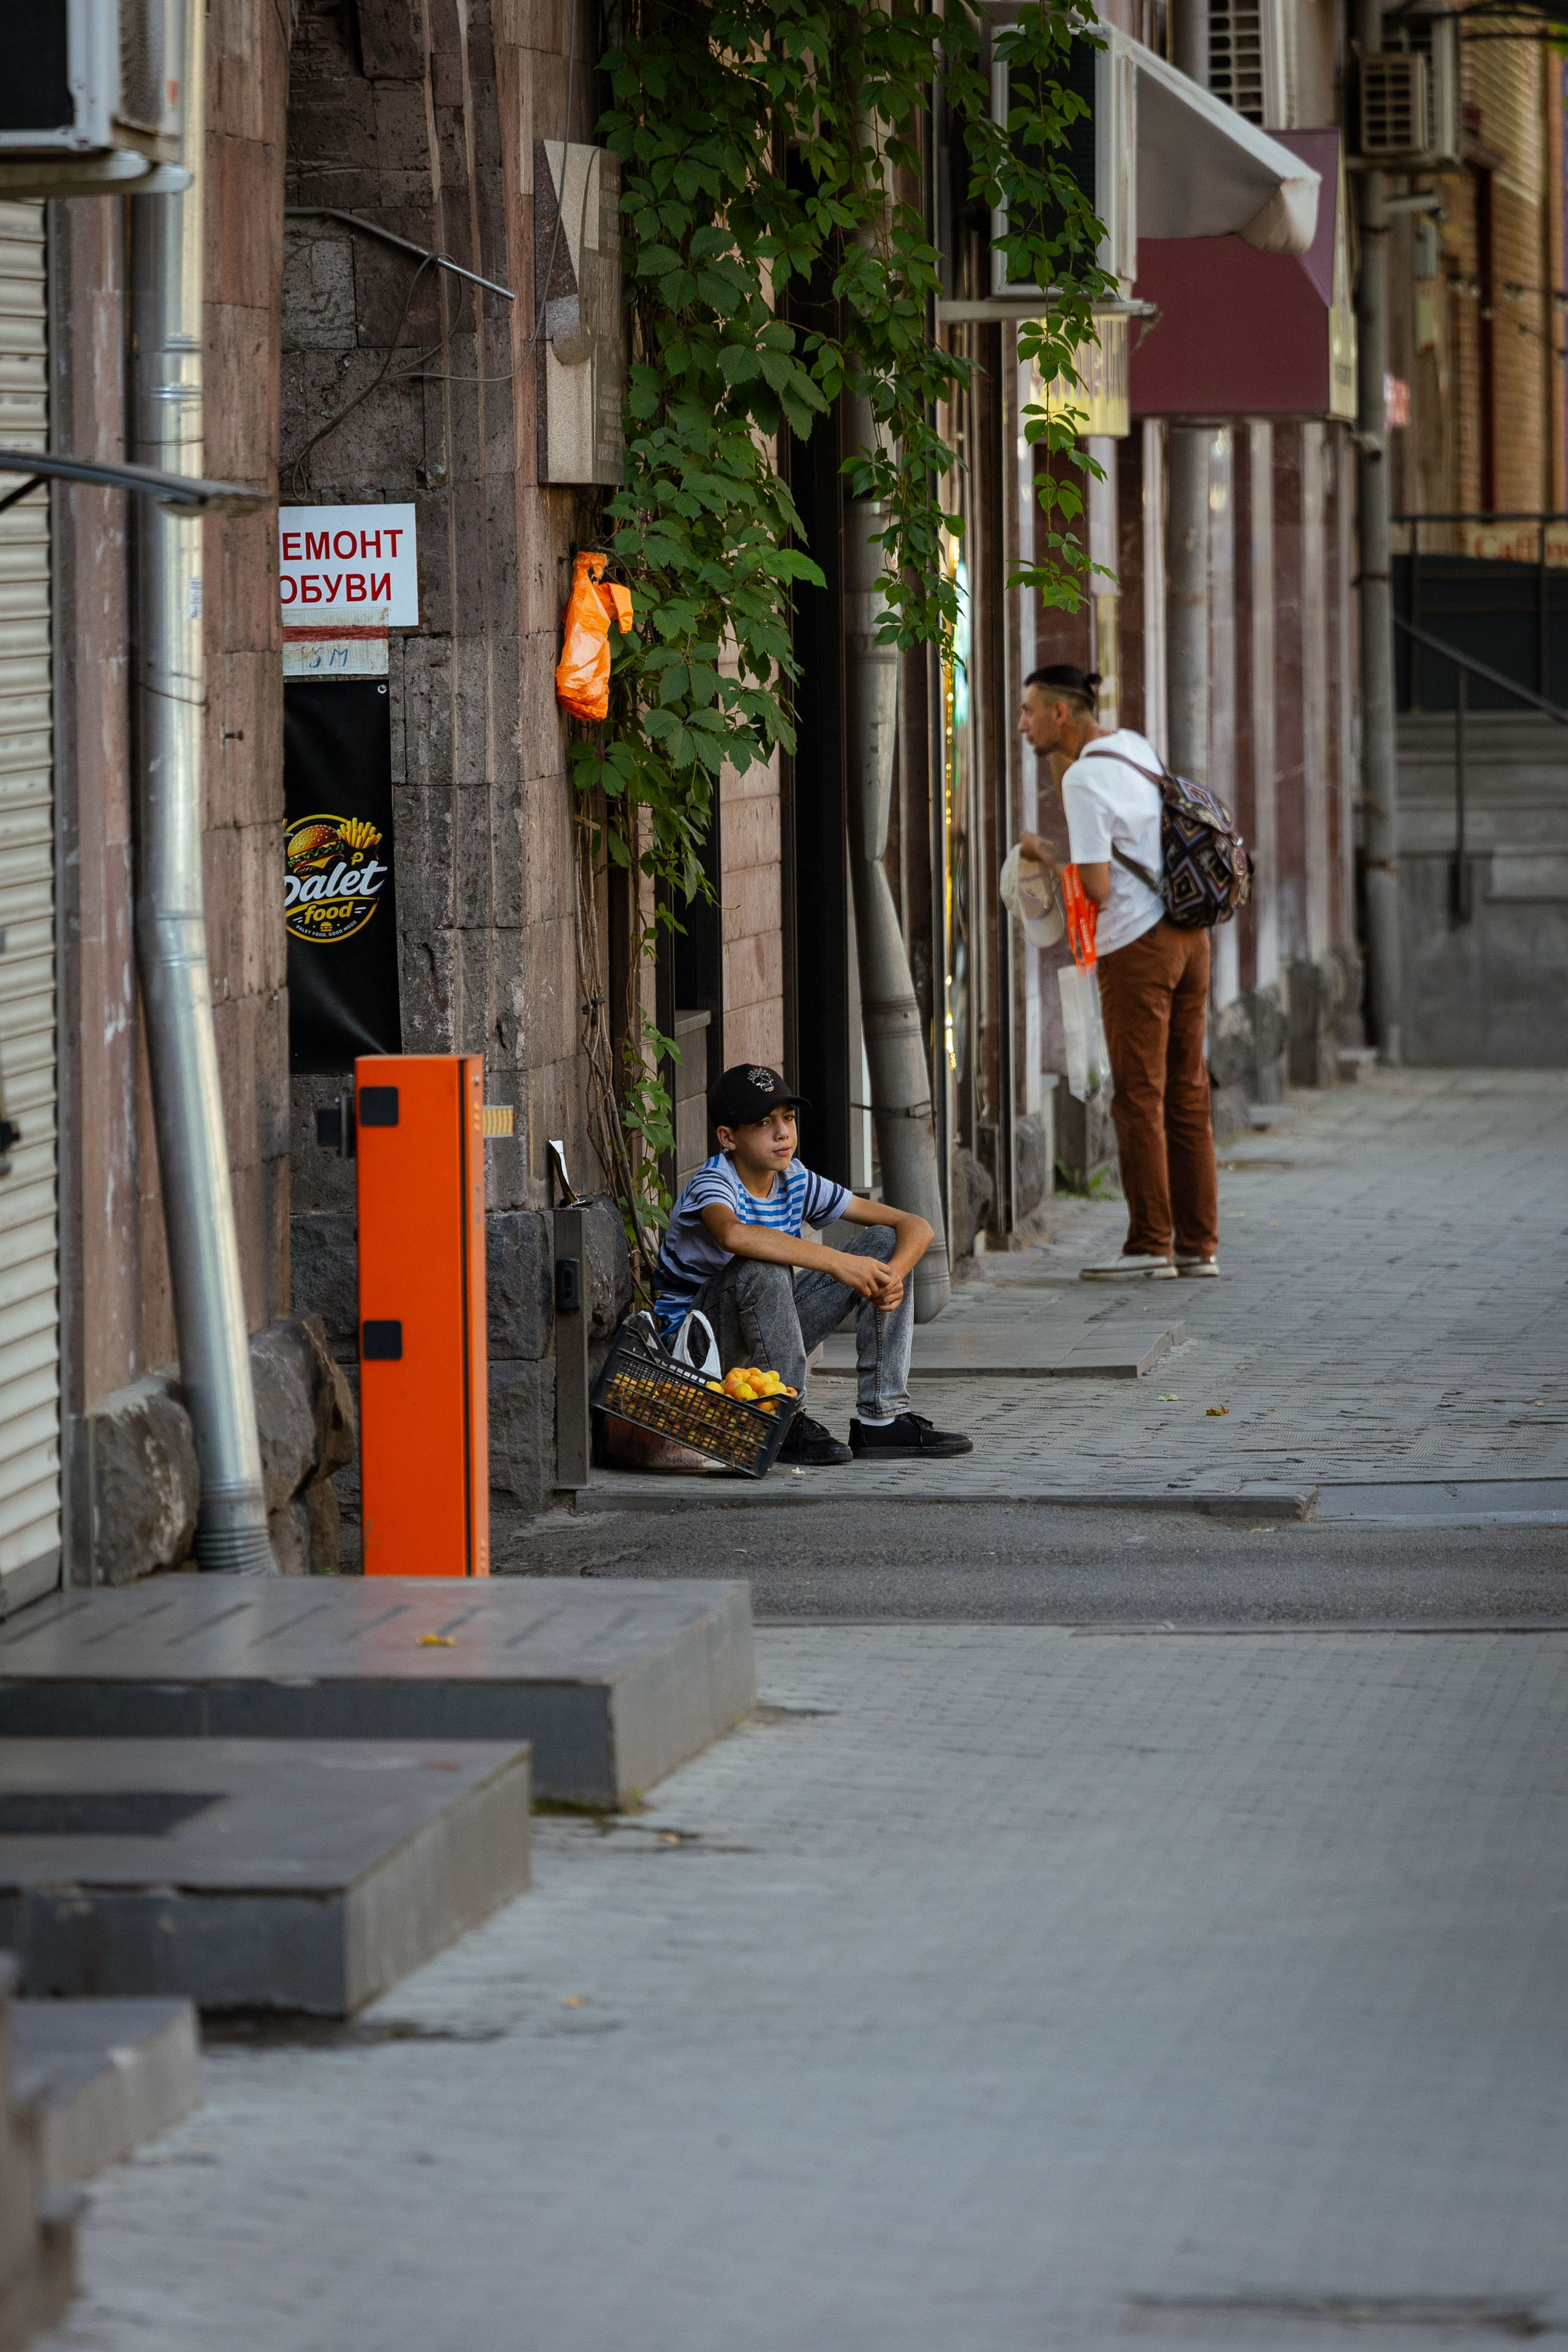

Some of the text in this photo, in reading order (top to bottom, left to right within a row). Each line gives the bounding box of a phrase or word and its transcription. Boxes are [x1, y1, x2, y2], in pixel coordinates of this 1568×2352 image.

[282, 529, 404, 561] ЕМОНТ
[279, 572, 391, 605] ОБУВИ
[304, 900, 354, 925] food
[296, 924, 311, 935] PALET
[343, 920, 357, 932] MOOD
